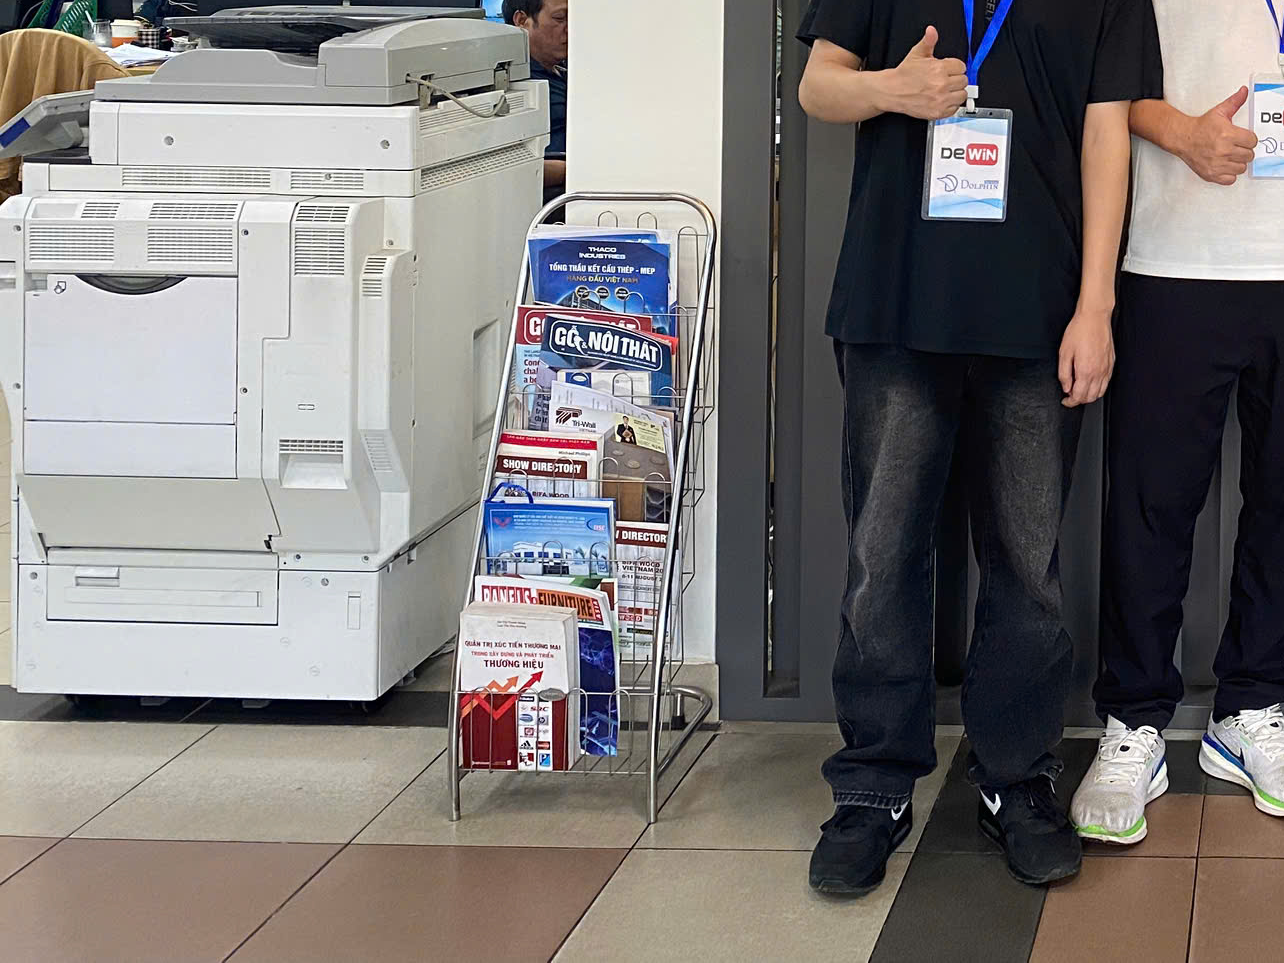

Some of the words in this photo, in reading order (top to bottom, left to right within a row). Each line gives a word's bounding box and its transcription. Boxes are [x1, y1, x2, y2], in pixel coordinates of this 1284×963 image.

[640, 267, 655, 275] MEP
[503, 458, 529, 470] SHOW
[531, 461, 582, 473] DIRECTORY
[621, 529, 667, 543] DIRECTOR
[538, 592, 593, 617] FURNITURE
[484, 659, 521, 668] THƯƠNG
[522, 657, 544, 669] HIỆU
